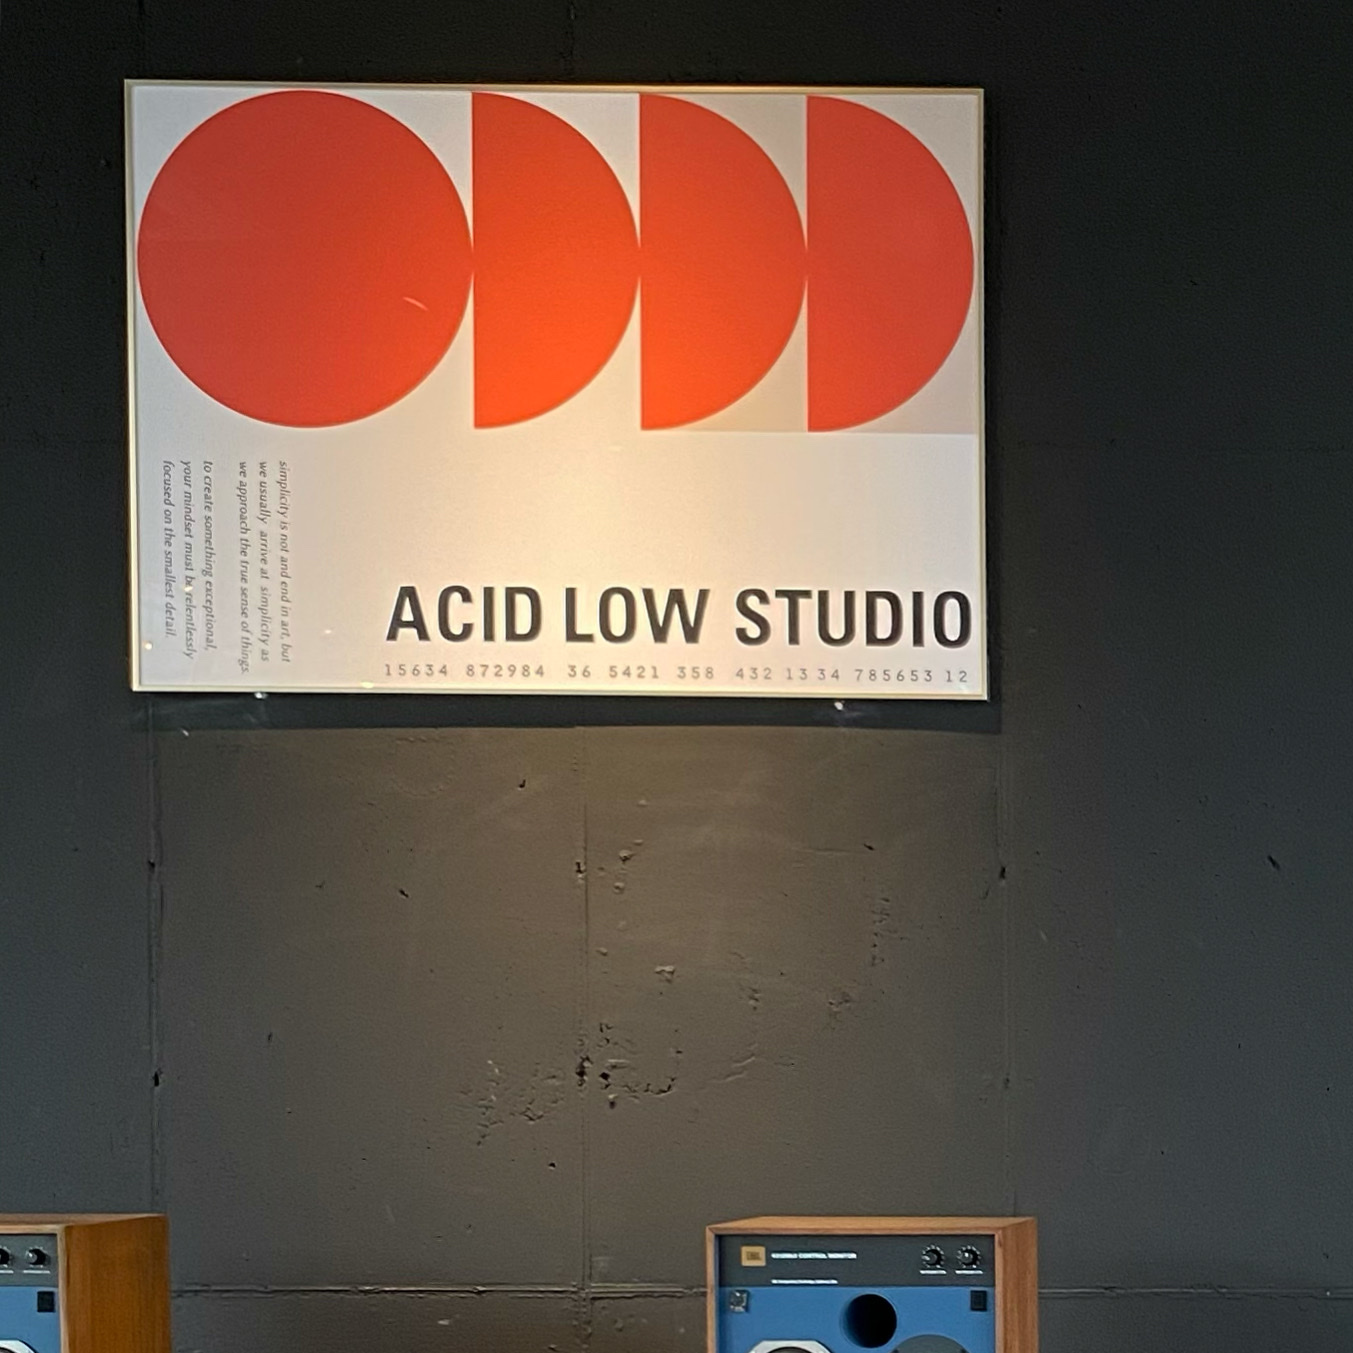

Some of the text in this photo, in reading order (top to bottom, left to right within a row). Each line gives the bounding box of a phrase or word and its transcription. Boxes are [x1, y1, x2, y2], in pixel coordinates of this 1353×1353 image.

[179, 460, 192, 489] your
[203, 460, 214, 474] to
[238, 461, 248, 478] we
[162, 460, 176, 507] focused
[203, 475, 214, 513] create
[274, 460, 292, 518] simplicity
[163, 508, 173, 525] on
[183, 490, 196, 539] mindset
[235, 480, 252, 535] approach
[163, 527, 177, 548] the
[279, 520, 289, 531] is
[200, 514, 217, 578] something
[239, 537, 252, 557] the
[279, 533, 290, 553] not
[184, 541, 195, 572] must
[255, 461, 273, 661] we usually arrive at simplicity as
[279, 555, 292, 579] and
[163, 550, 177, 599] smallest
[240, 560, 250, 584] true
[240, 586, 249, 619] sense
[280, 580, 292, 603] end
[280, 605, 289, 617] in
[386, 584, 973, 650] ACID LOW STUDIO
[182, 591, 198, 659] relentlessly
[240, 620, 254, 635] of
[280, 643, 293, 663] but
[384, 662, 449, 678] 15634
[465, 663, 545, 679] 872984
[567, 663, 592, 679] 36
[608, 664, 660, 680] 5421
[676, 665, 715, 681] 358
[734, 666, 773, 681] 432
[853, 667, 934, 684] 785653
[945, 669, 968, 684] 12
